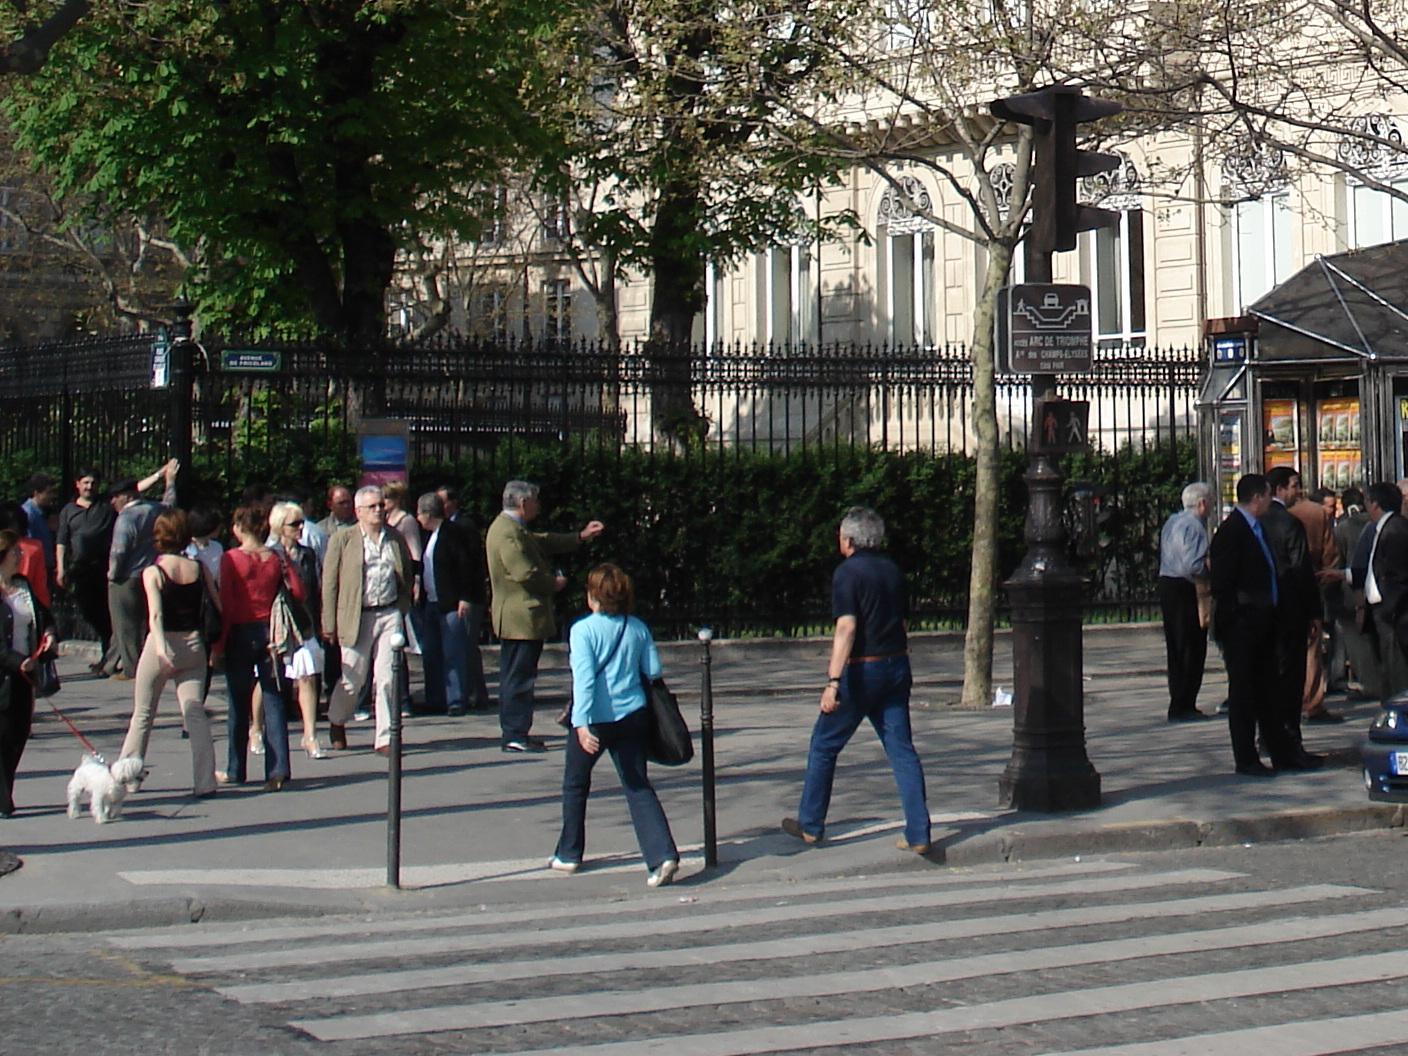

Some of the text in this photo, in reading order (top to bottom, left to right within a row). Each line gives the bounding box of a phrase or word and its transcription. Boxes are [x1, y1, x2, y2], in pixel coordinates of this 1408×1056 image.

[1029, 335, 1043, 346] ARC
[1044, 335, 1054, 346] DE
[1056, 335, 1088, 346] TRIOMPHE
